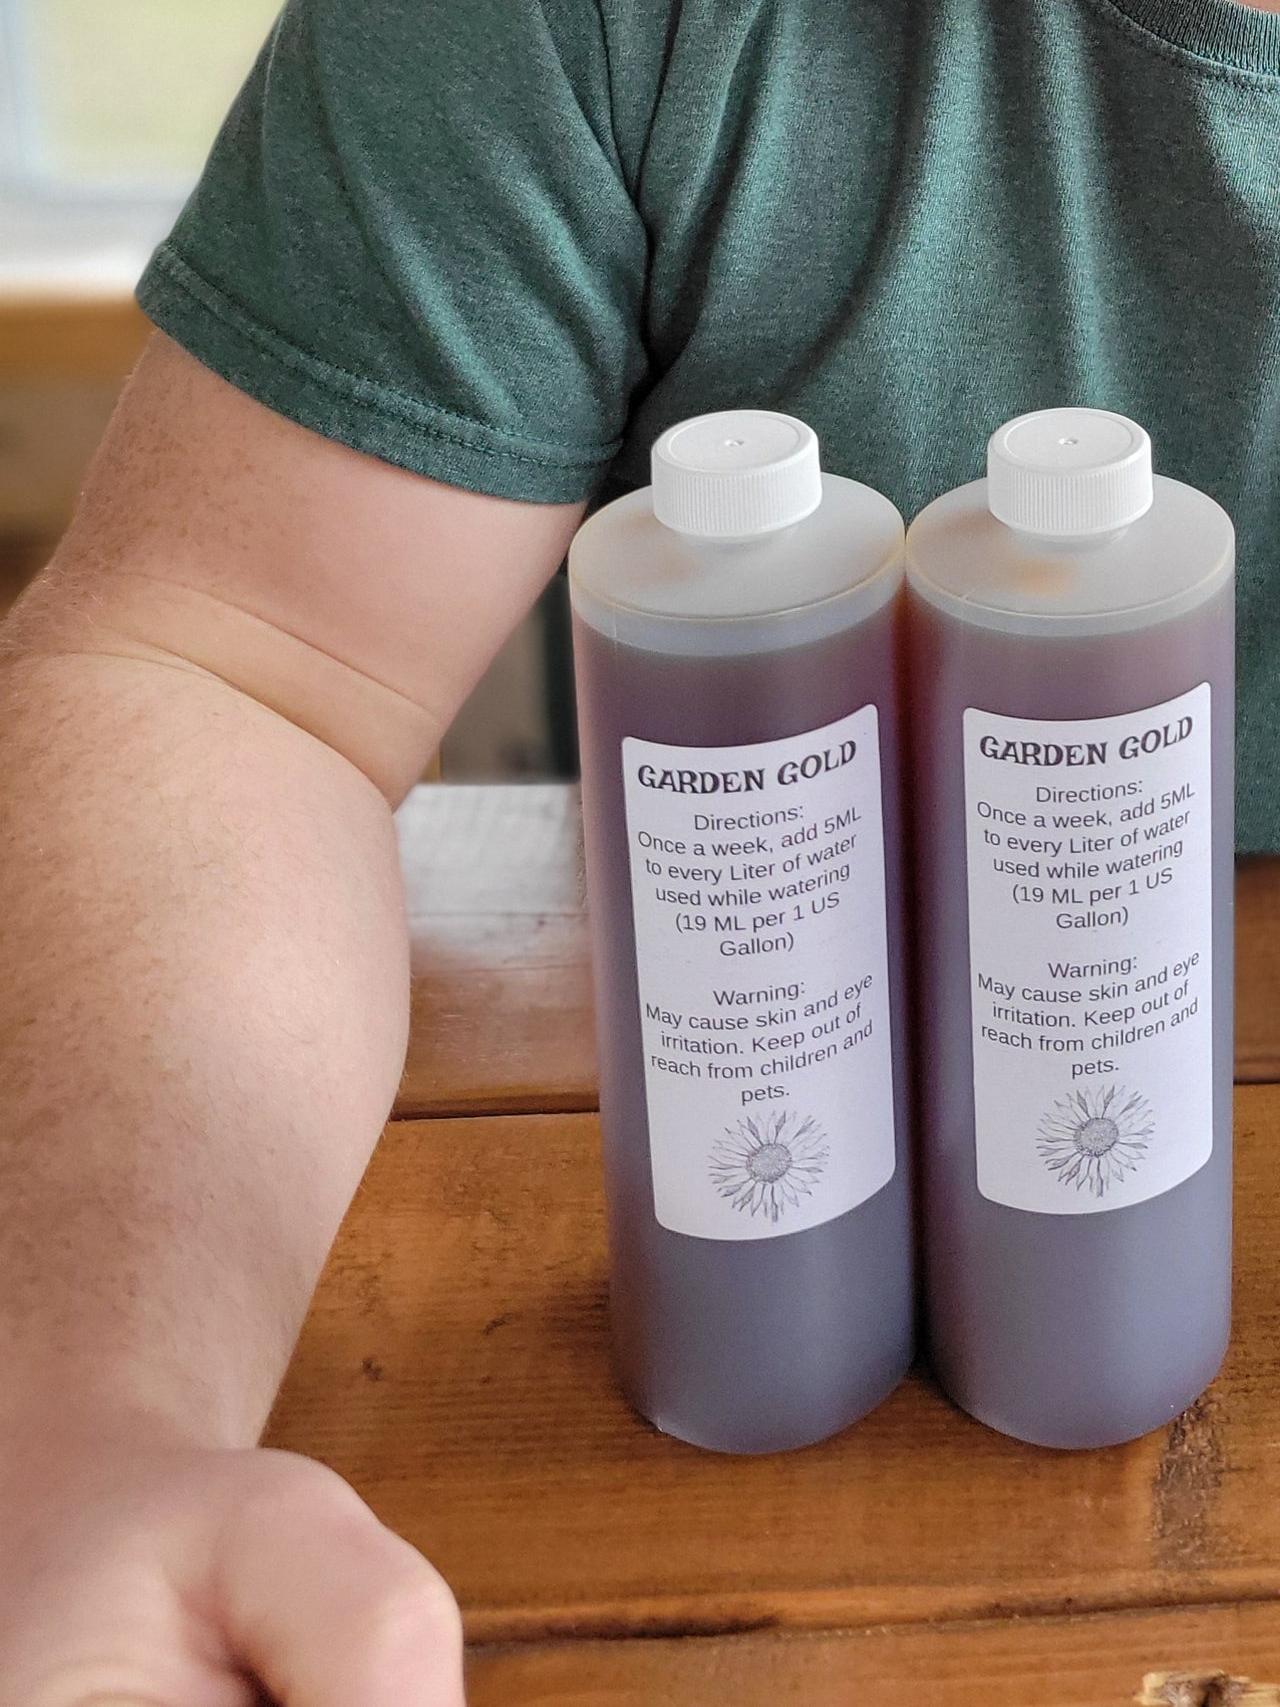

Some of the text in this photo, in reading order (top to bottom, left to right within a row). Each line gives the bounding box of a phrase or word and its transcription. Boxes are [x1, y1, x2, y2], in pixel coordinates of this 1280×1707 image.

[980, 716, 1192, 766] GARDEN GOLD
[638, 740, 856, 794] GARDEN GOLD
[977, 783, 1195, 828] Once a week, add 5ML
[1036, 781, 1142, 803] Directions:
[638, 807, 861, 856] Once a week, add 5ML
[694, 806, 803, 830] Directions:
[984, 811, 1190, 857] to every Liter of water
[646, 834, 856, 885] to every Liter of water
[994, 837, 1182, 878] used while watering
[656, 863, 849, 906] used while watering
[1013, 868, 1172, 906] (19 ML per 1 US
[676, 892, 839, 933] (19 ML per 1 US
[1056, 906, 1128, 929] Gallon)
[720, 932, 794, 956] Gallon)
[978, 953, 1199, 1003] May cause skin and eye
[1048, 957, 1137, 978] Warning:
[646, 975, 872, 1030] May cause skin and eye
[713, 982, 804, 1006] Warning:
[993, 979, 1188, 1027] irritation. Keep out of
[661, 1002, 861, 1054] irritation. Keep out of
[982, 997, 1197, 1051] reach from children and
[651, 1019, 872, 1079] reach from children and
[1072, 1060, 1119, 1080] pets.
[742, 1086, 789, 1106] pets.
